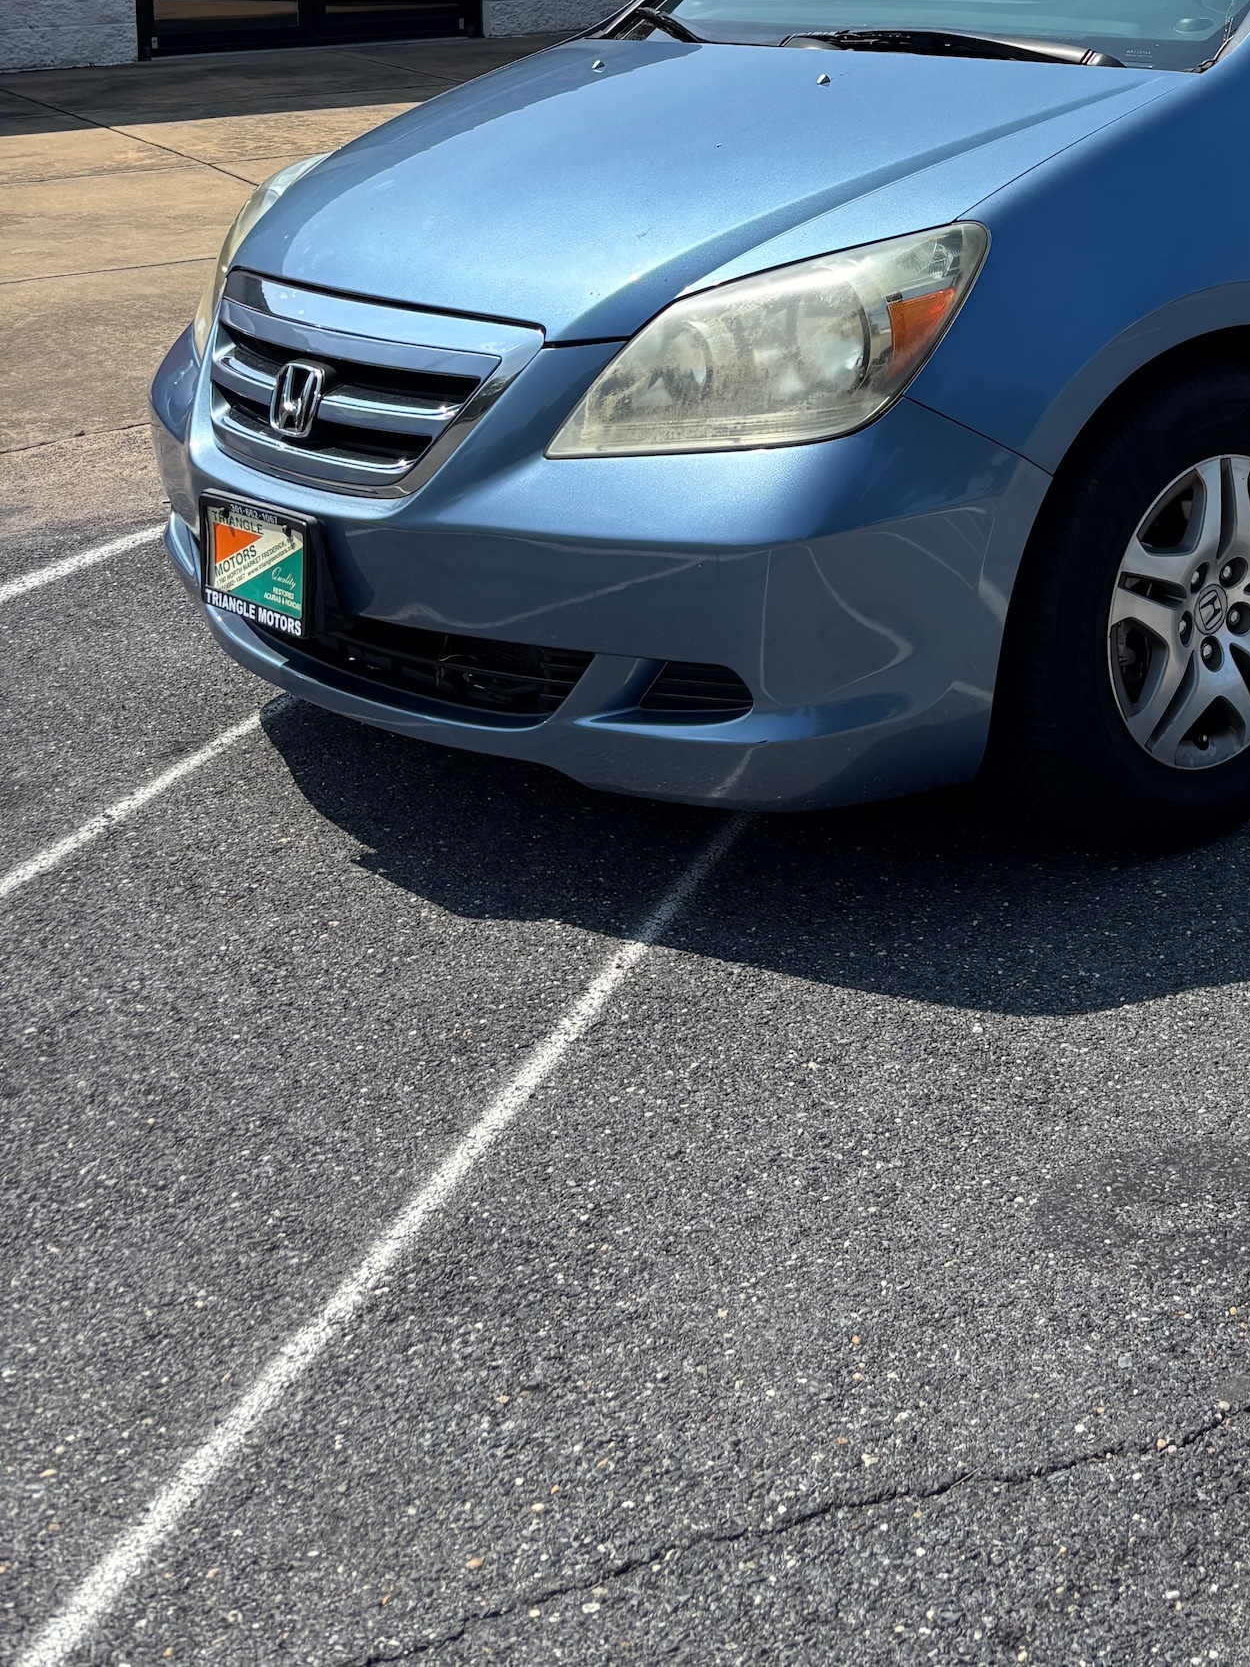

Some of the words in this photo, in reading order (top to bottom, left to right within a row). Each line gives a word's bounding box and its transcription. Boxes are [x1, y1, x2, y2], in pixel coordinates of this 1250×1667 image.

[215, 544, 257, 578] MOTORS
[271, 566, 297, 591] Quality
[205, 588, 256, 620] TRIANGLE
[258, 606, 302, 636] MOTORS
